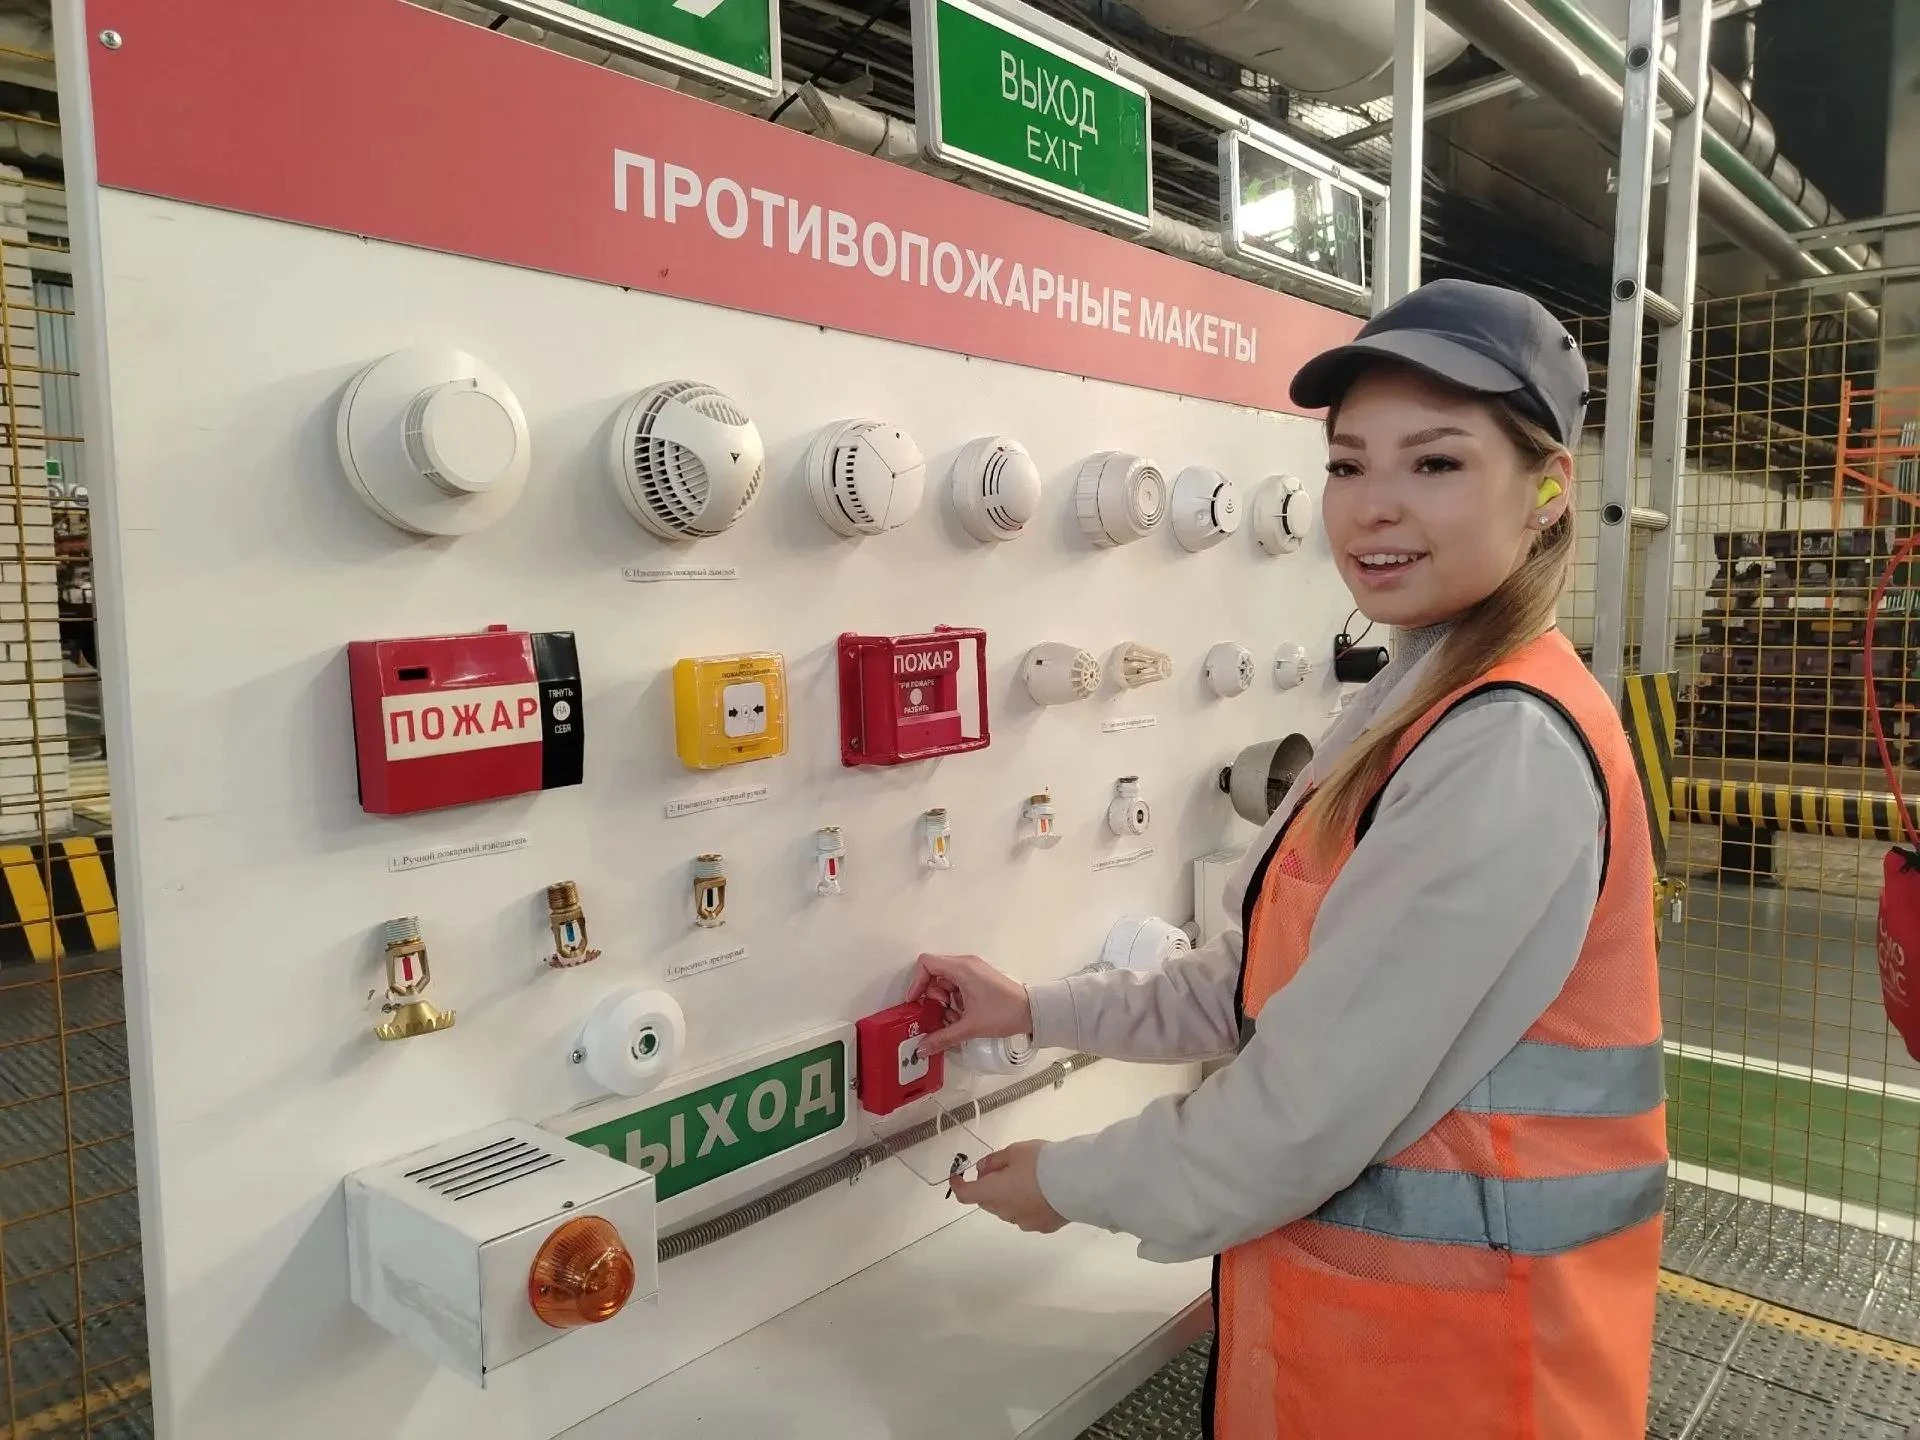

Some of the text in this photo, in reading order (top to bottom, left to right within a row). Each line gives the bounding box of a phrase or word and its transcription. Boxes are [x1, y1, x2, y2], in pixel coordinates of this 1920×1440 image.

[1001, 49, 1098, 145] ВЫХОД
[1027, 124, 1082, 176] EXIT
[614, 148, 1257, 374] ПРОТИВОПОЖАРНЫЕ МАКЕТЫ
[894, 650, 953, 674] ПОЖАР
[548, 688, 573, 698] ТЯНУТЬ
[389, 697, 538, 744] ПОЖАР
[556, 704, 568, 716] НА
[904, 705, 929, 714] РАЗБИТЬ
[554, 723, 572, 734] СЕБЯ
[403, 851, 435, 866] Ручной
[437, 844, 480, 861] пожарный
[482, 836, 527, 851] извещатель
[586, 1058, 836, 1176] ЫХОД
